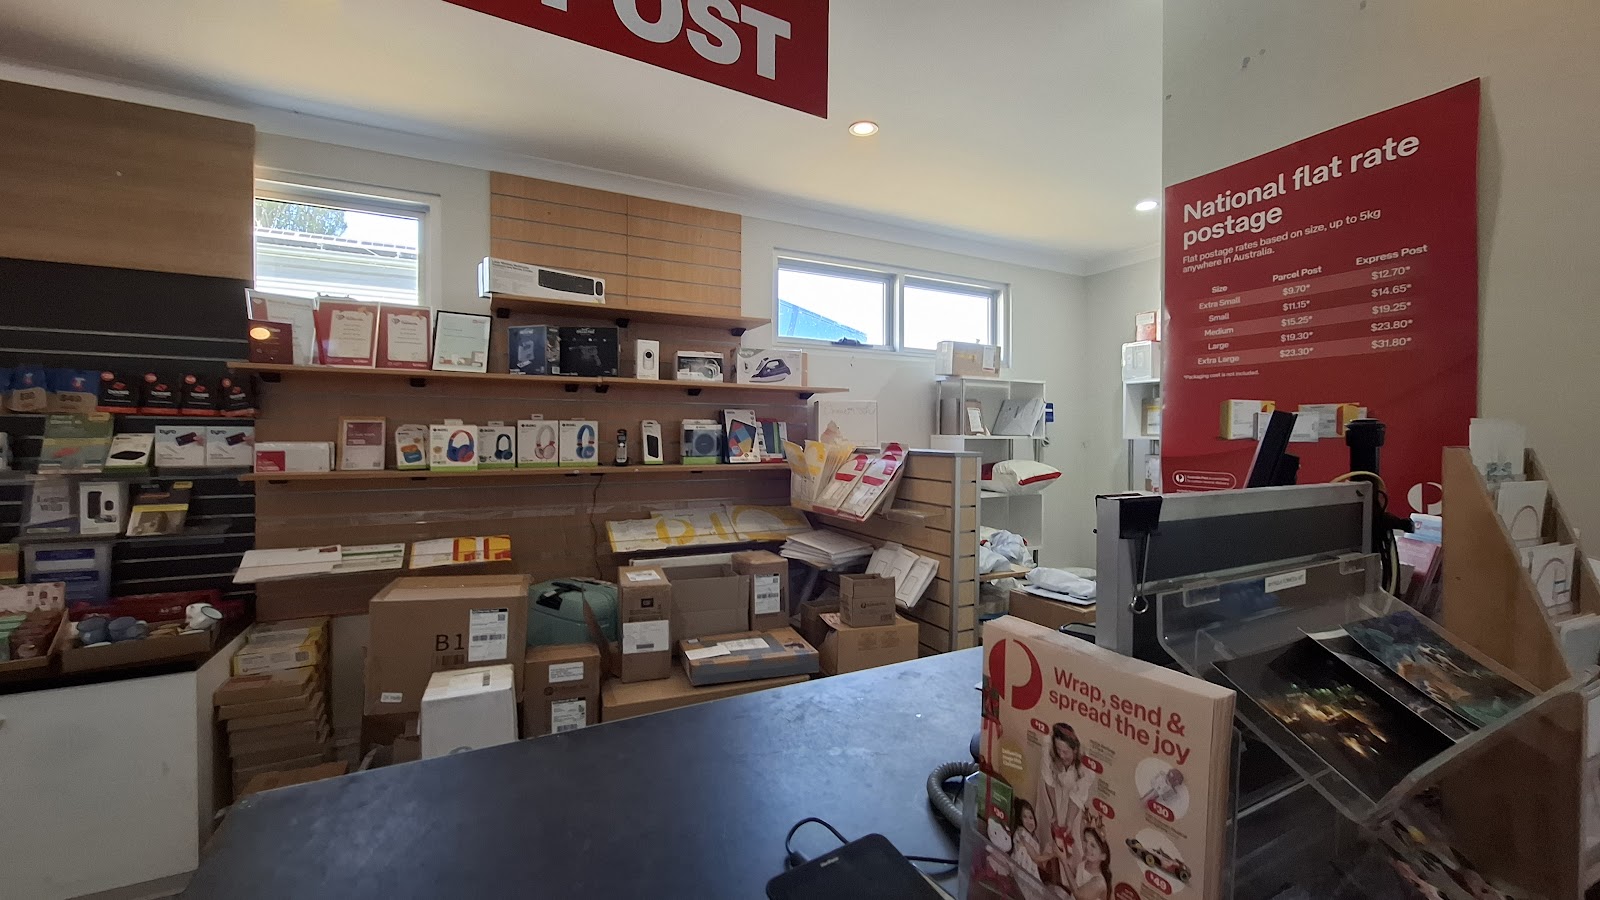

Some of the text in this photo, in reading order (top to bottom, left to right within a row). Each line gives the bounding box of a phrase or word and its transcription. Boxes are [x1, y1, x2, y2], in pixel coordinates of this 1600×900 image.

[541, 0, 792, 80] OST
[1184, 136, 1420, 223] National flat rate
[1182, 209, 1381, 264] Flat postage rates based on size, up to 5kg
[1183, 206, 1283, 250] postage
[1182, 246, 1275, 273] anywhere in Australia.
[1355, 244, 1428, 266] Express Post
[1272, 266, 1322, 282] Parcel Post
[1211, 285, 1228, 294] Size
[1199, 296, 1241, 310] Extra Small
[1208, 312, 1230, 322] Small
[1204, 327, 1234, 337] Medium
[1207, 342, 1229, 351] Large
[1197, 356, 1240, 365] Extra Large
[435, 633, 465, 651] B1
[1053, 666, 1186, 737] Wrap, send &
[1048, 690, 1111, 728] spread
[1114, 713, 1150, 745] the
[1152, 729, 1191, 765] joy
